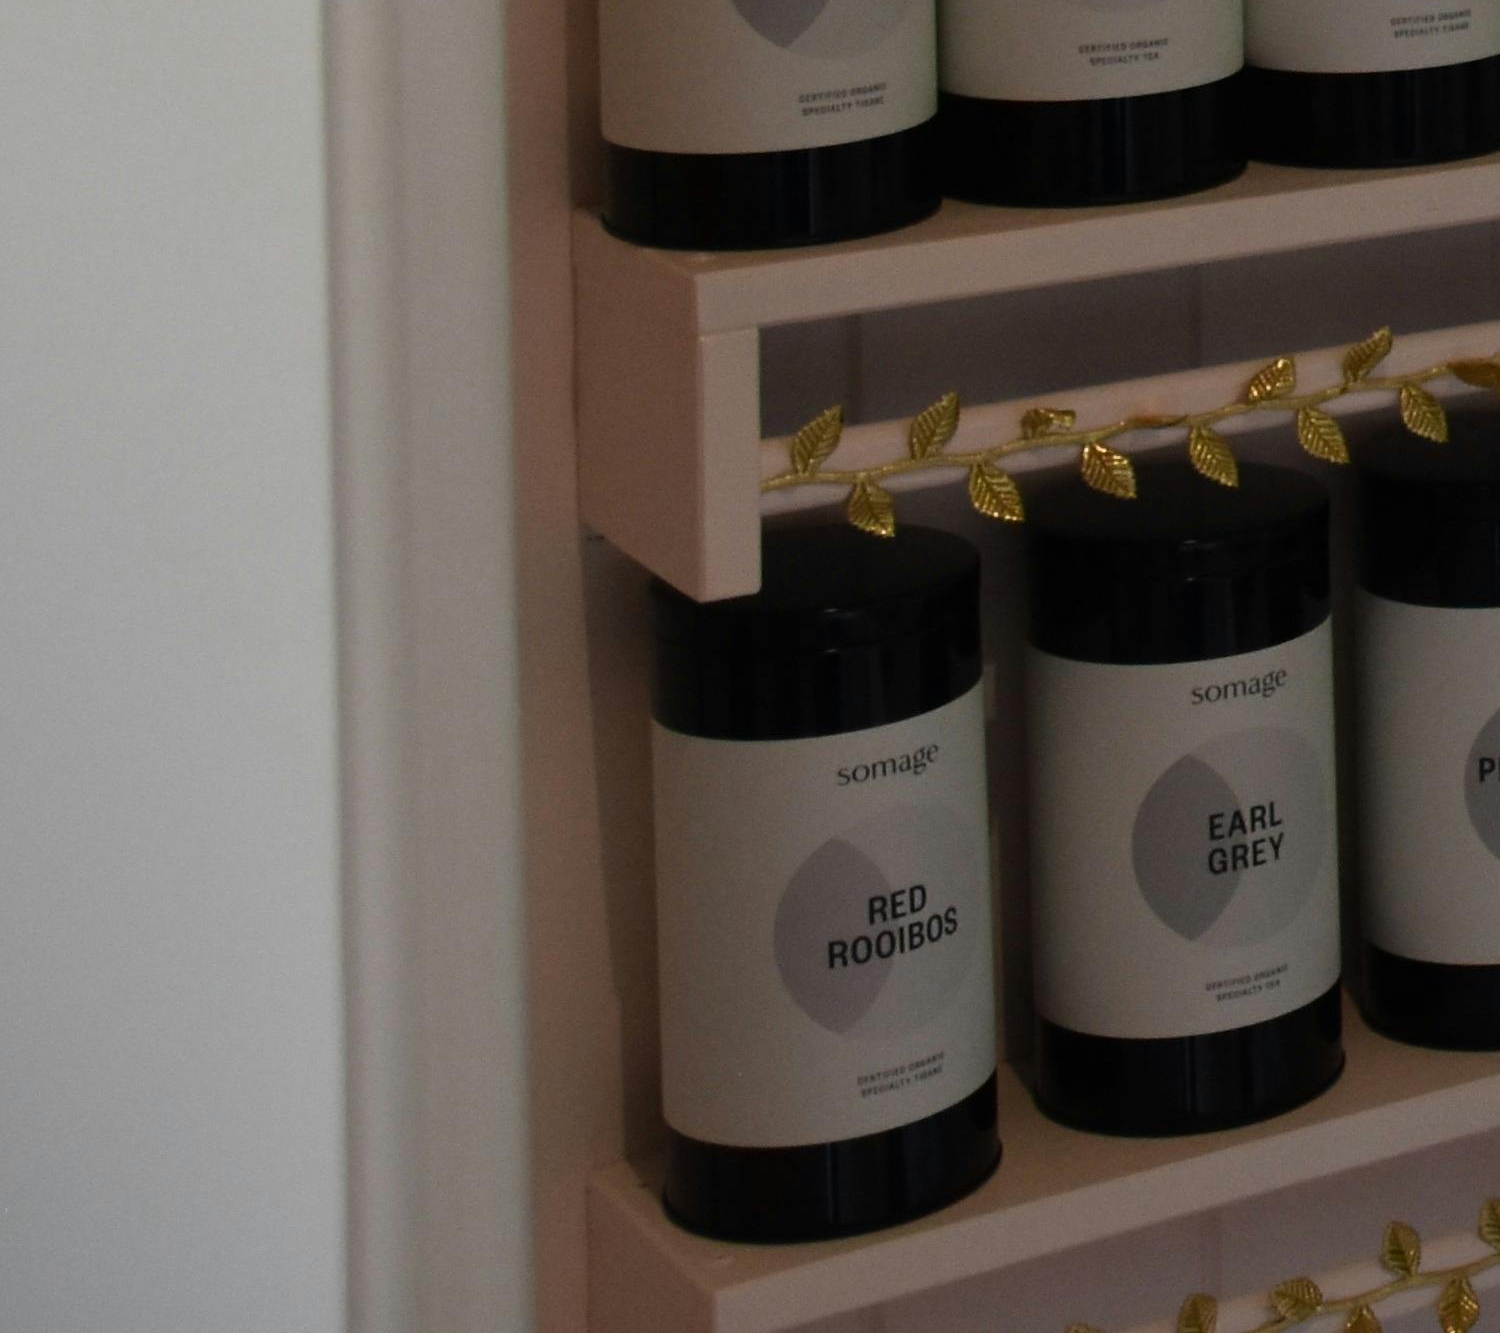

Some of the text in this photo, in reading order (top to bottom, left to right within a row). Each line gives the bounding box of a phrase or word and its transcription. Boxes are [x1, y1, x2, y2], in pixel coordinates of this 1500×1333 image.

[1191, 668, 1288, 706] somage
[836, 742, 939, 787] somage
[1208, 800, 1283, 841] EARL
[1208, 832, 1285, 875] GREY
[868, 883, 927, 926] RED
[827, 904, 959, 970] ROOIBOS
